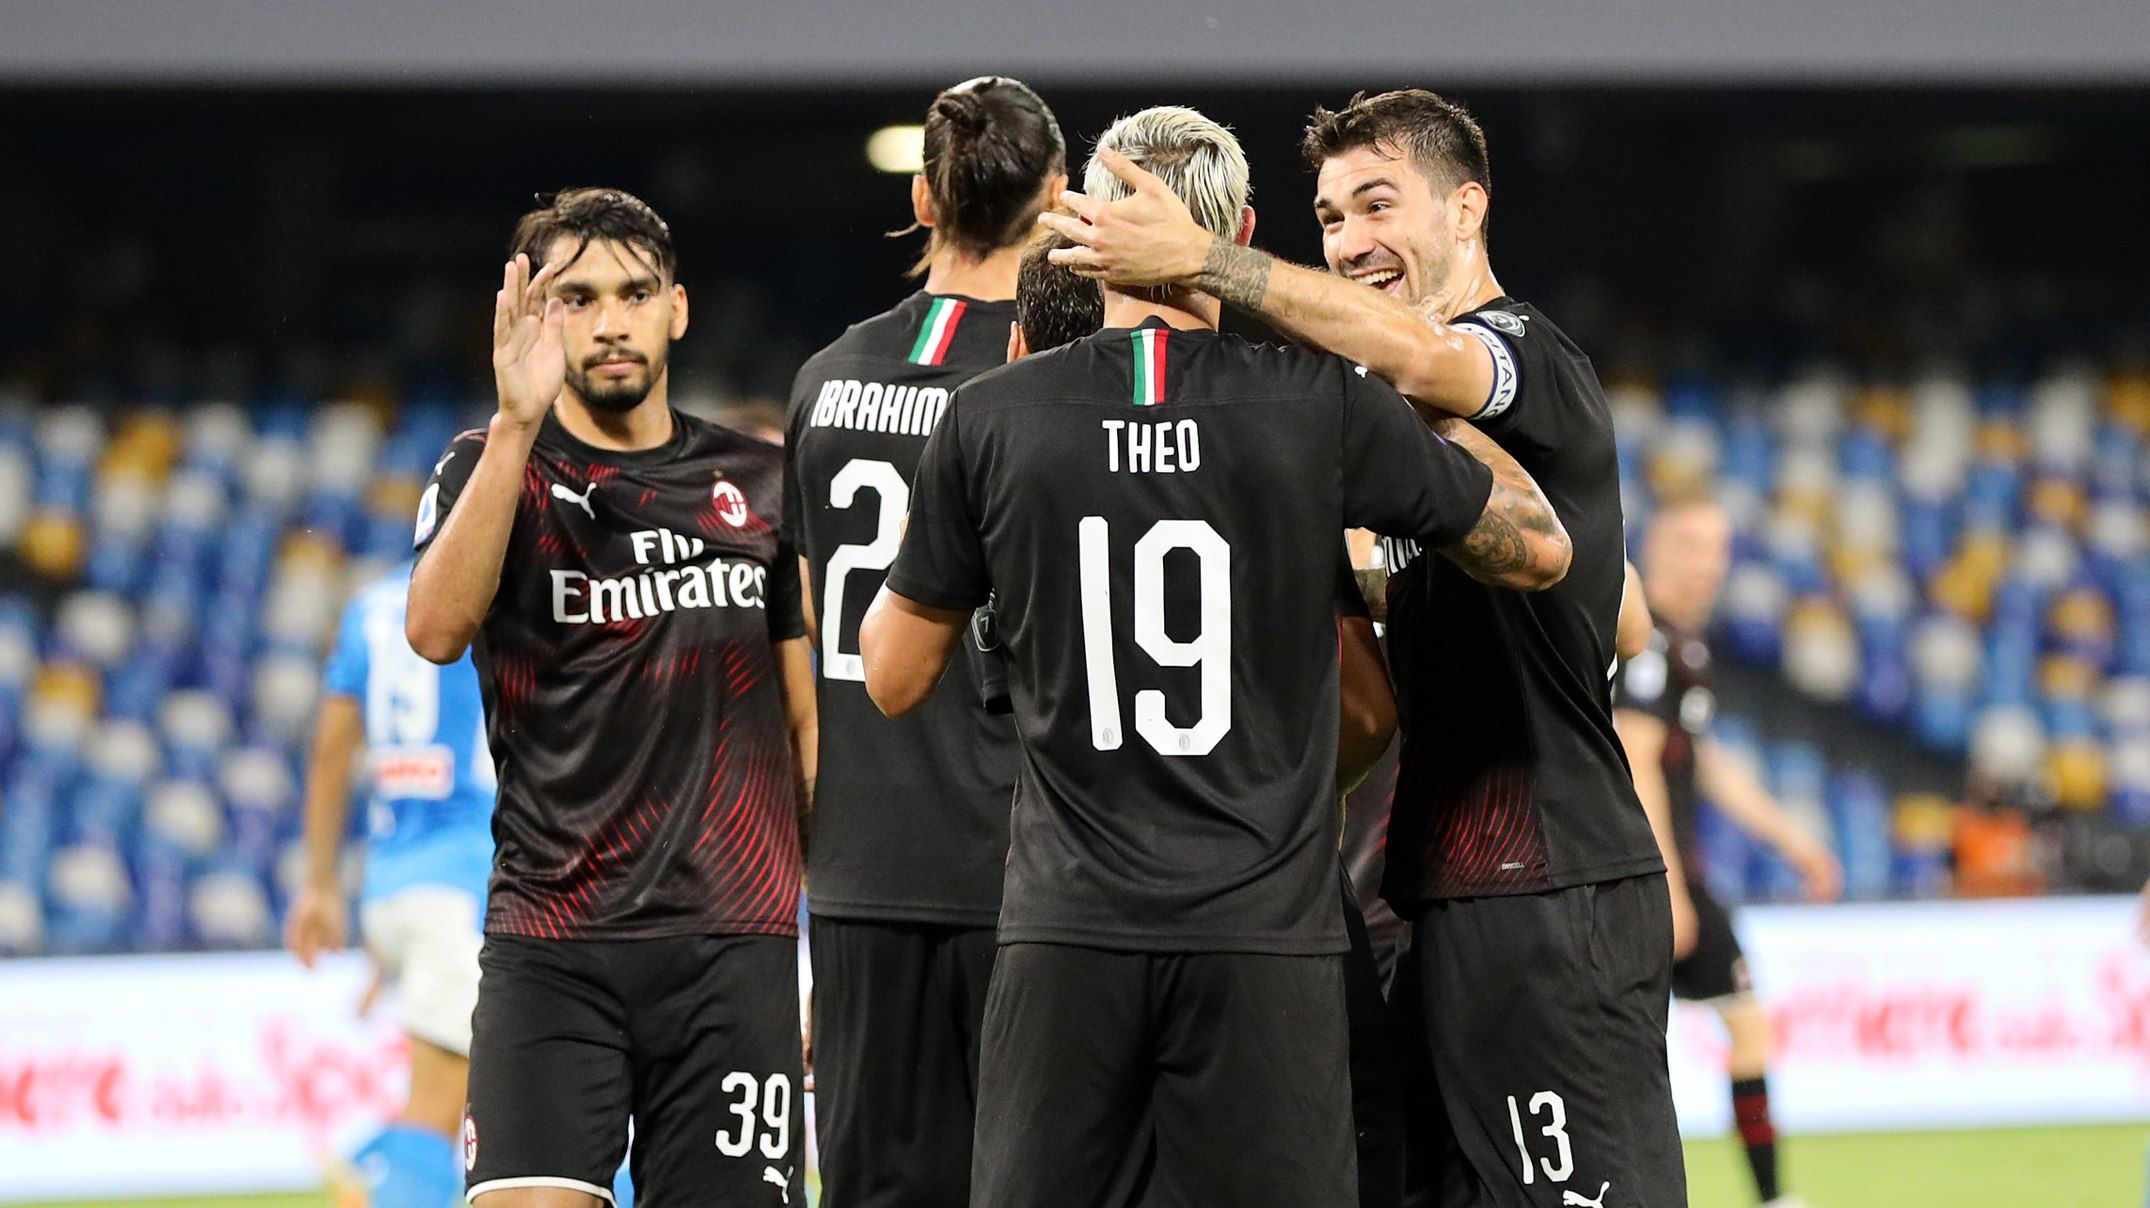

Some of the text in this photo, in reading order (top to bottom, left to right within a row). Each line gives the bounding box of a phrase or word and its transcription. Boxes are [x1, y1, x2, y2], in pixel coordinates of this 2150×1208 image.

[1102, 419, 1200, 473] THEO
[630, 528, 704, 565] Fly
[549, 557, 767, 625] Emirates
[1079, 516, 1231, 756] 19
[715, 1071, 791, 1160] 39
[1507, 1090, 1574, 1184] 13
